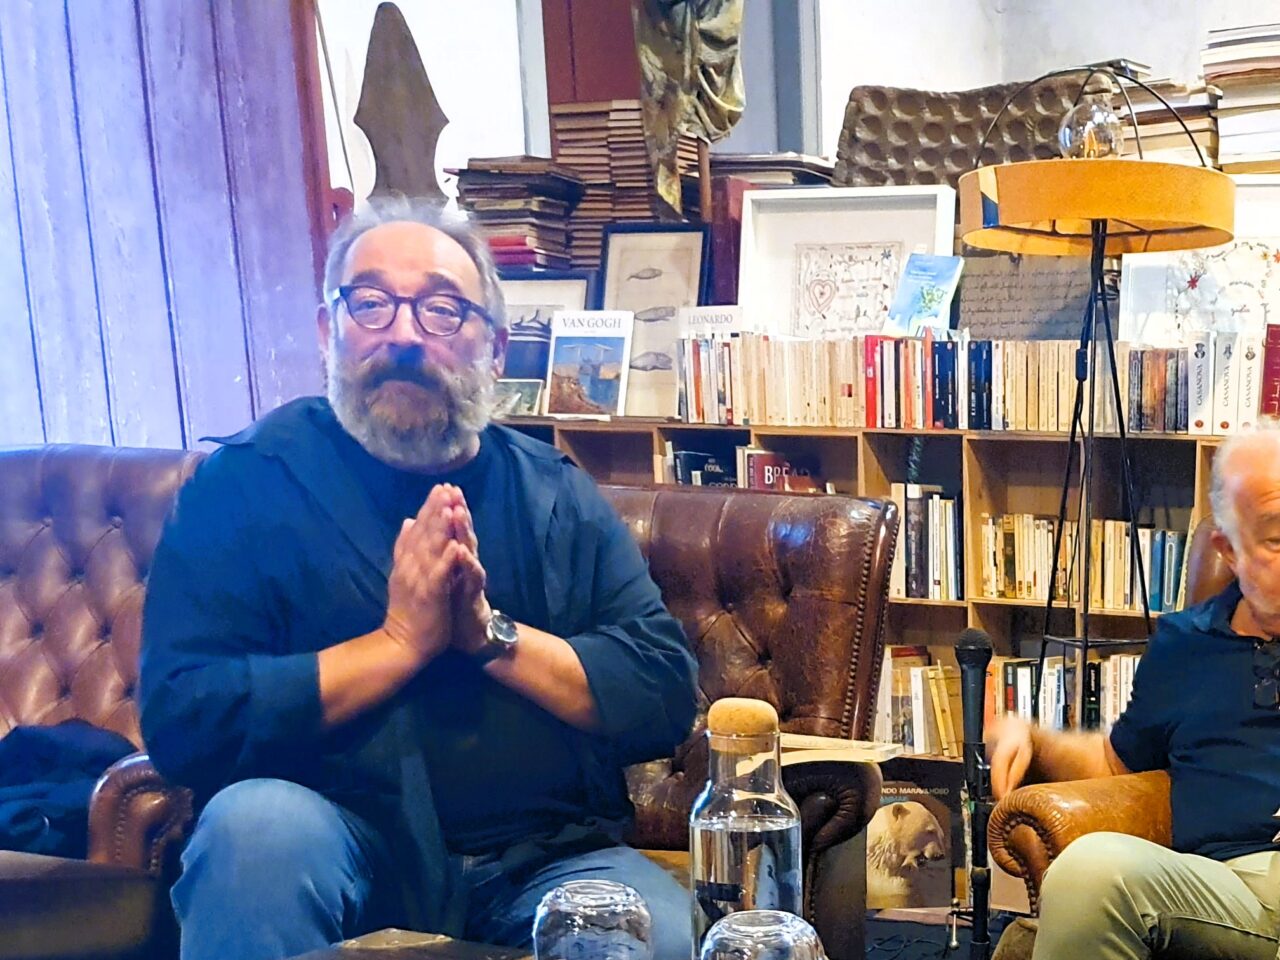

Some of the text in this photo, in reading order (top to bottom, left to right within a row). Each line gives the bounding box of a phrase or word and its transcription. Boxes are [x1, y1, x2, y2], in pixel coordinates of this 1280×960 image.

[562, 317, 622, 329] VAN GOGH
[688, 313, 733, 325] LEONARDO
[881, 787, 898, 795] NDO
